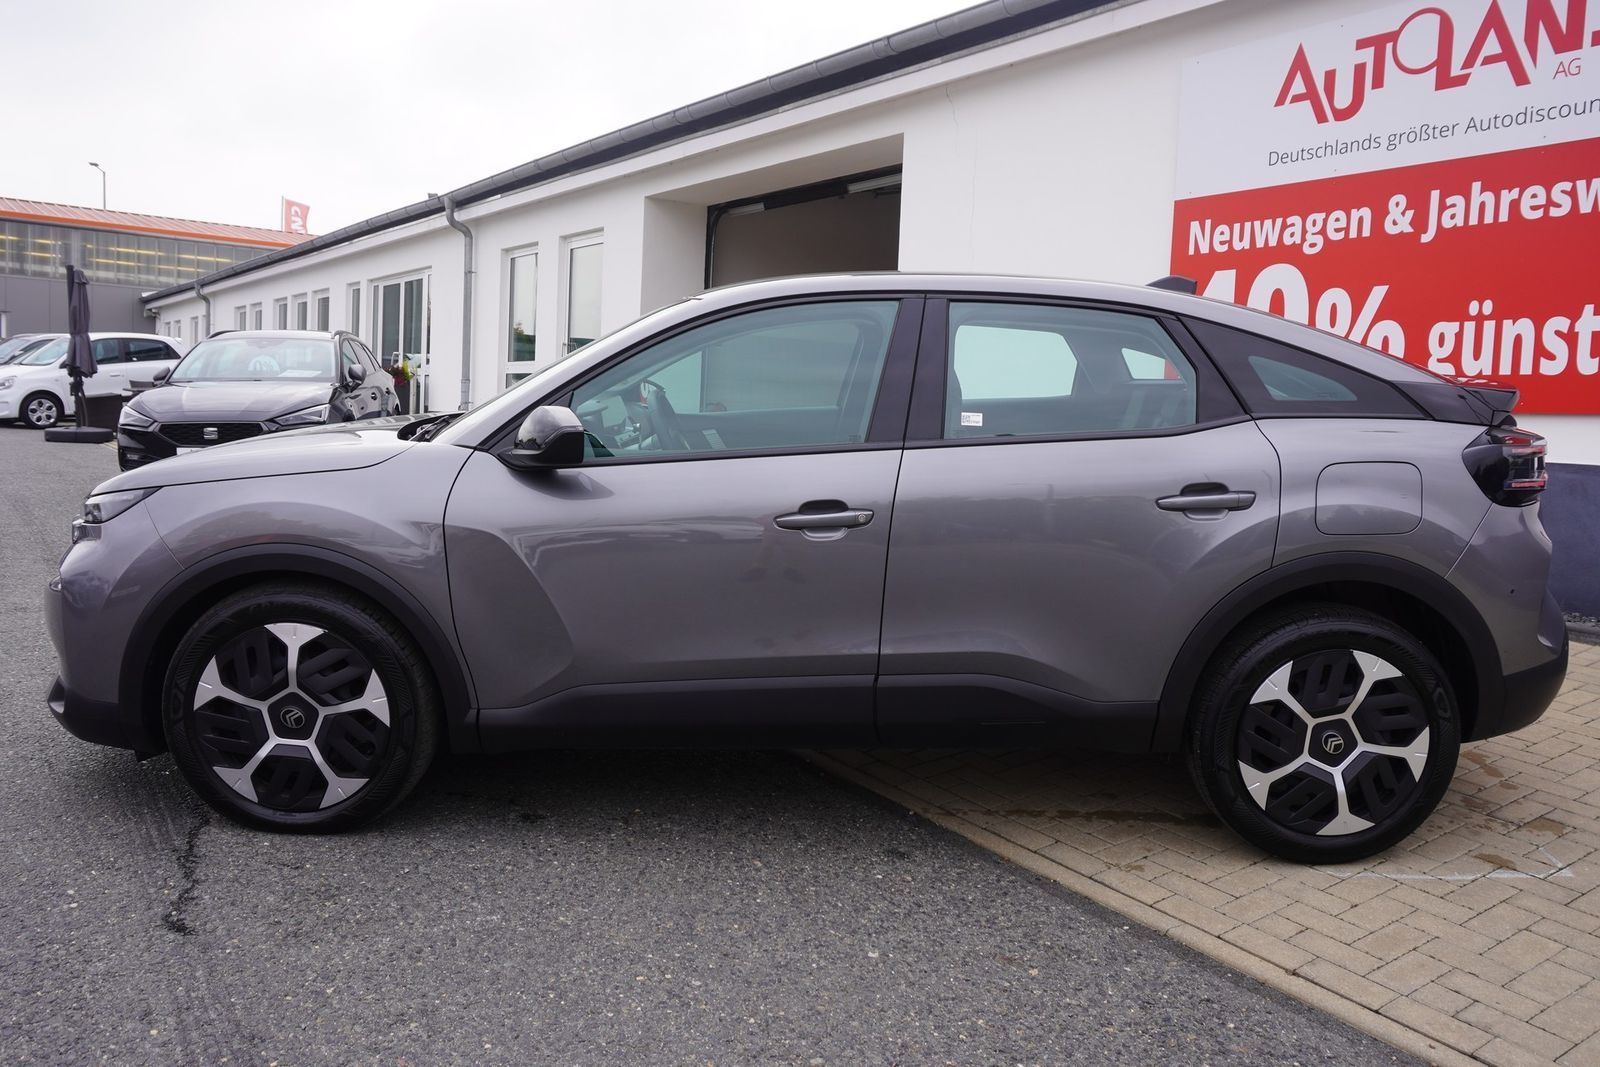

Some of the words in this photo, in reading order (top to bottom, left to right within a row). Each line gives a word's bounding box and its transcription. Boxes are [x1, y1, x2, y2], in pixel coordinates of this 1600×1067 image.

[1274, 0, 1600, 124] AUTOLAN
[1552, 57, 1582, 80] AG
[1268, 133, 1382, 166] Deutschlands
[1386, 122, 1460, 151] größter
[1187, 206, 1373, 255] Neuwagen
[1384, 193, 1415, 235] &
